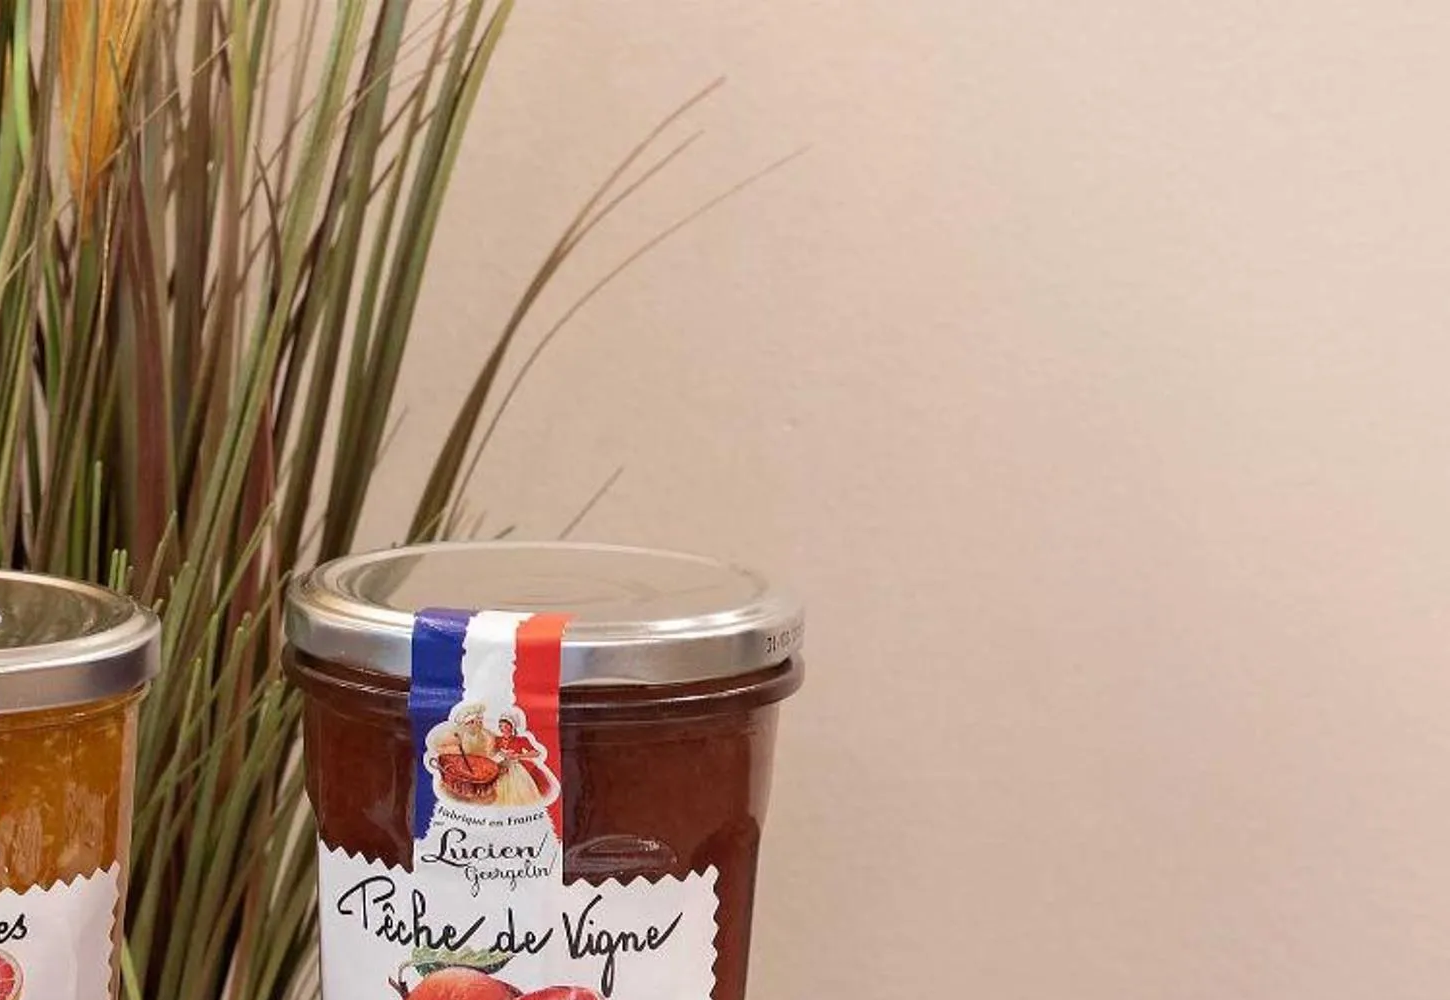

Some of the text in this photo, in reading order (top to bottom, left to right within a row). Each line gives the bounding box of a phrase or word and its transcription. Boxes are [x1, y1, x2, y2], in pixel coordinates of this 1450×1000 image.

[421, 827, 548, 868] Lucien
[464, 855, 557, 898] Georgelin
[337, 875, 683, 997] Pêche de Vigne
